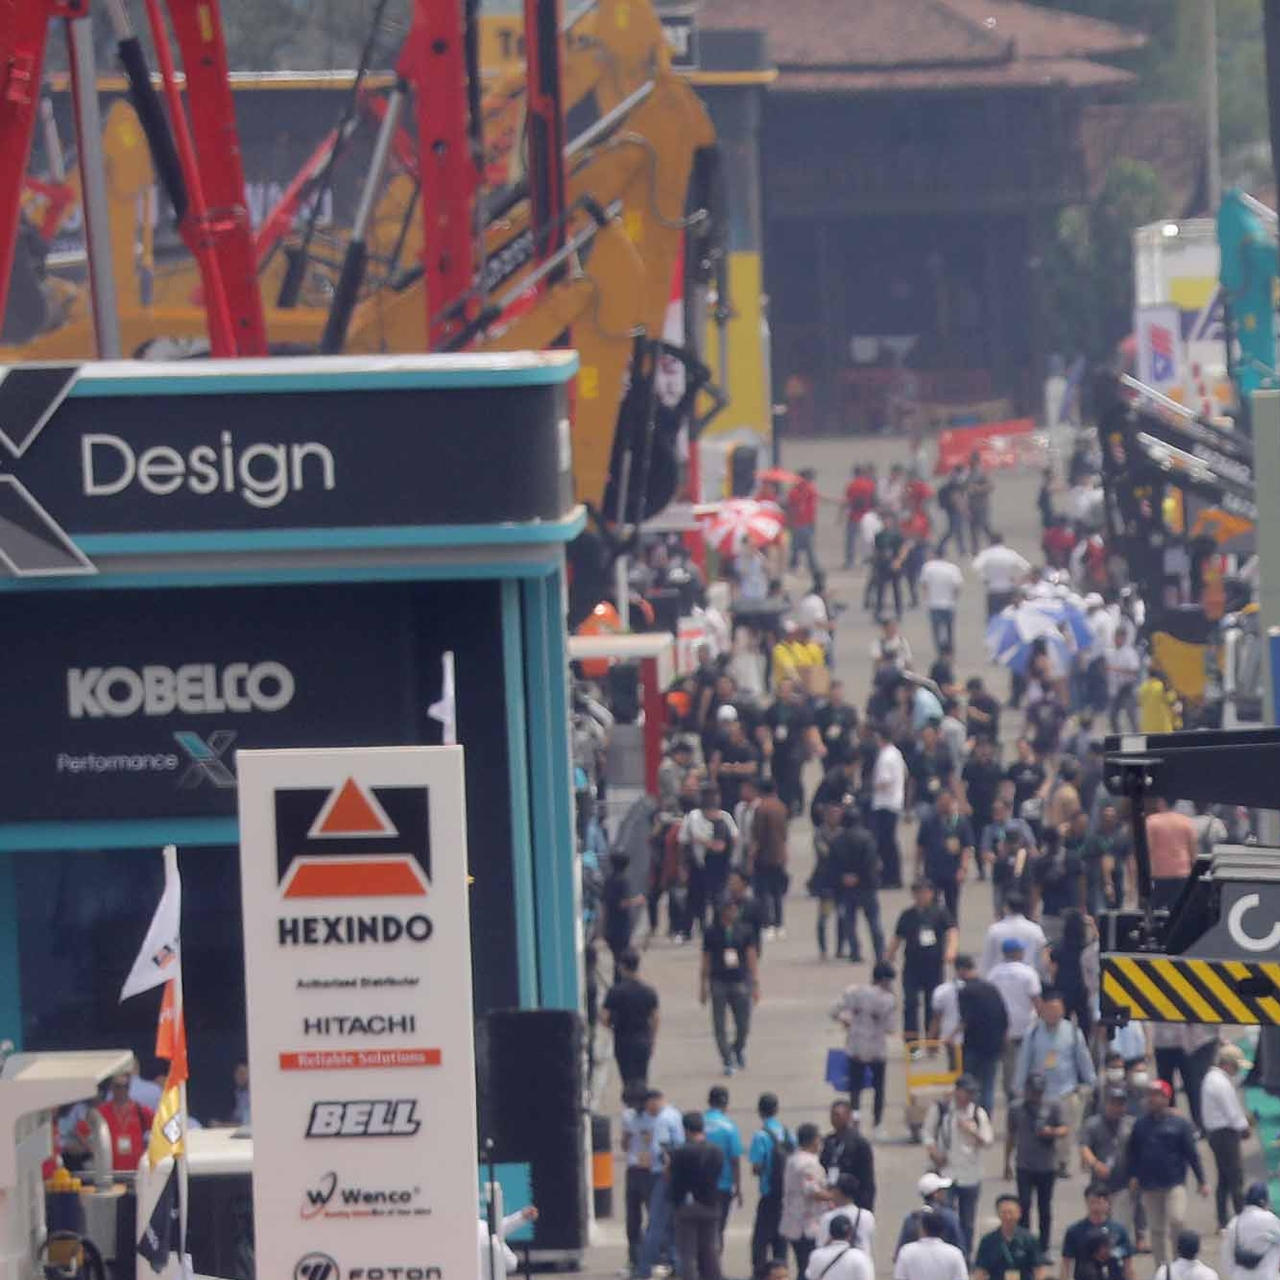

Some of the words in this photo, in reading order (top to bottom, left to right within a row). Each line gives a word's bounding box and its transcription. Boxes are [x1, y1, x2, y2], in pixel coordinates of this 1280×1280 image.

[81, 431, 335, 508] Design
[67, 661, 295, 718] KOBELCO
[56, 752, 179, 773] Performance
[278, 914, 433, 945] HEXINDO
[303, 1015, 416, 1035] HITACHI
[305, 1100, 421, 1138] BELL
